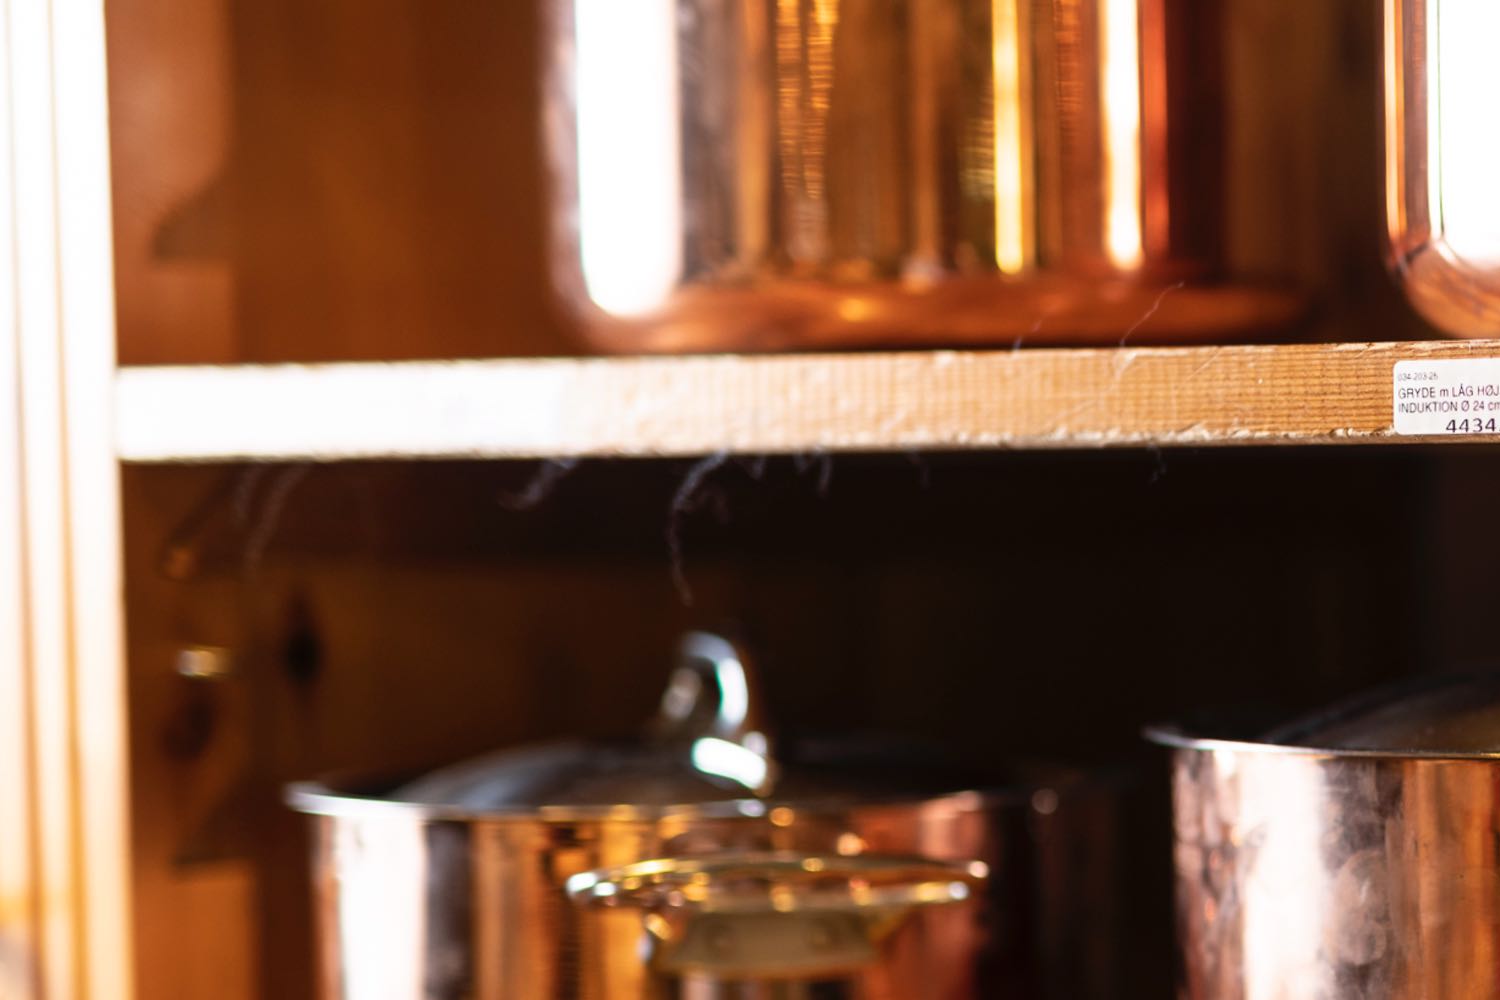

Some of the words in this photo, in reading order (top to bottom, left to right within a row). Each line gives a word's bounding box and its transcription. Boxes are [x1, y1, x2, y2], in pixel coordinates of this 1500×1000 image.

[1398, 387, 1436, 399] GRYDE
[1439, 388, 1449, 397] m
[1452, 384, 1474, 398] LÅG
[1399, 402, 1458, 413] INDUKTION
[1473, 401, 1485, 411] 24
